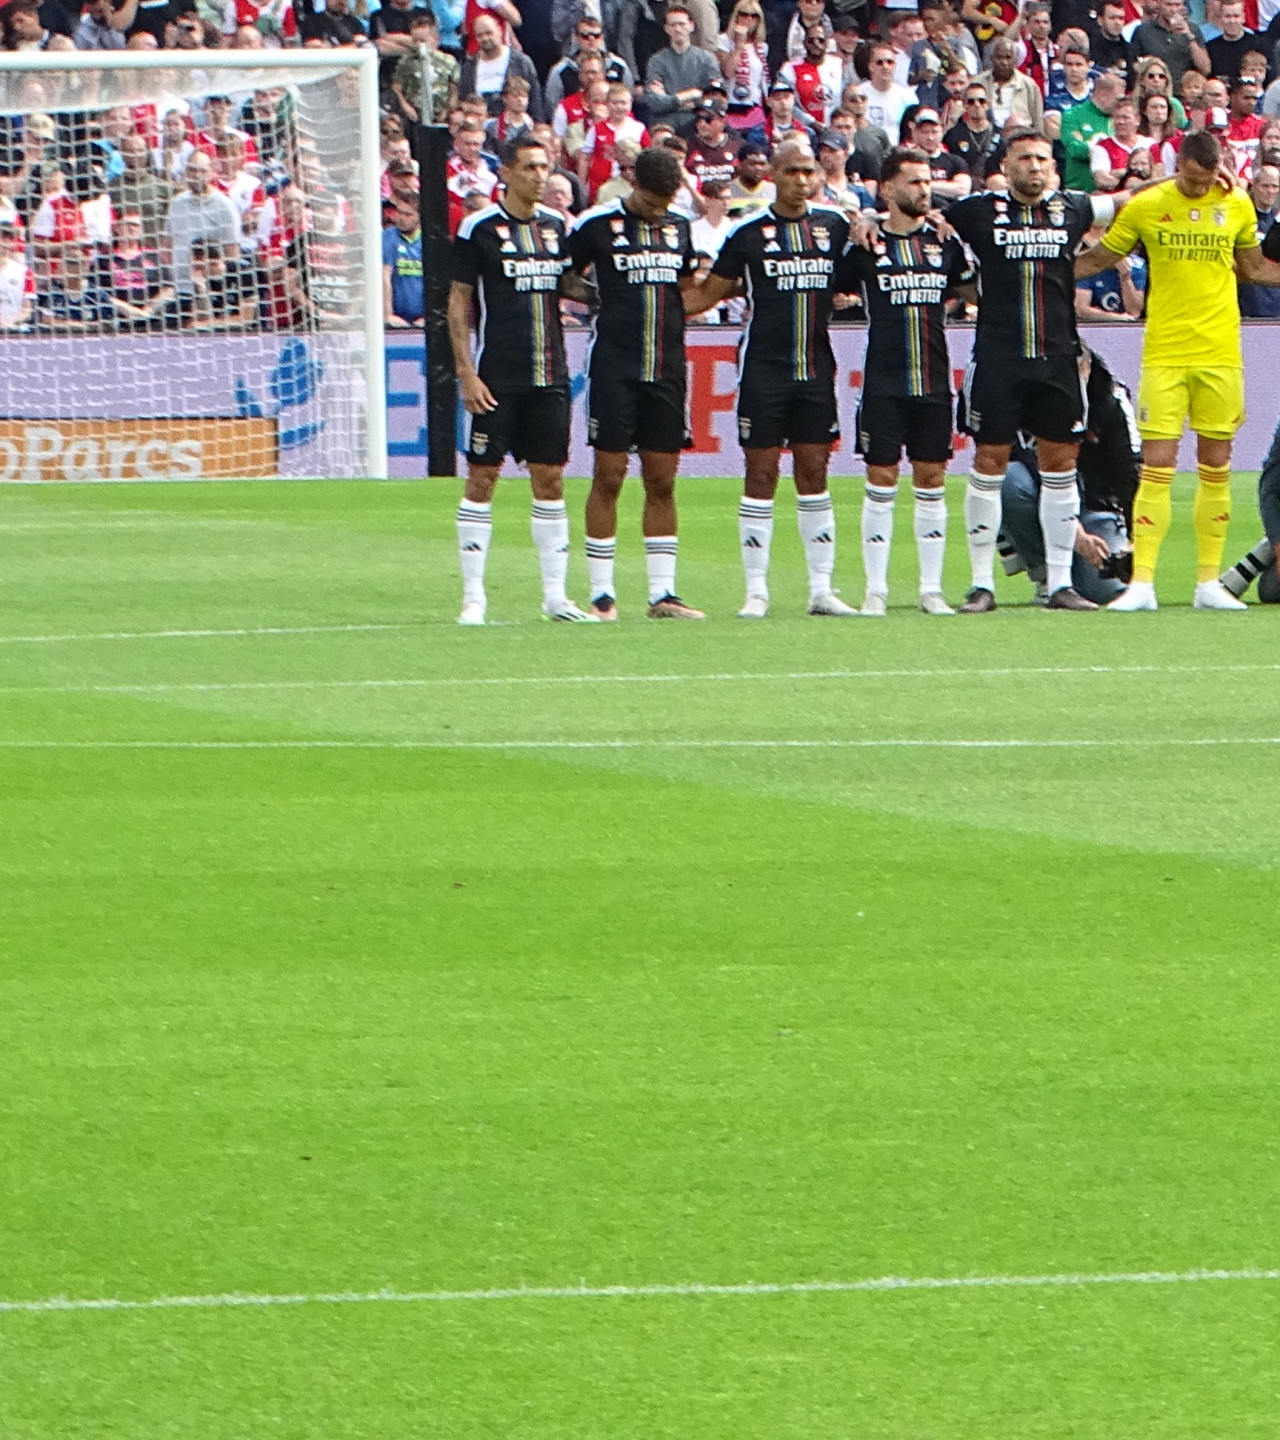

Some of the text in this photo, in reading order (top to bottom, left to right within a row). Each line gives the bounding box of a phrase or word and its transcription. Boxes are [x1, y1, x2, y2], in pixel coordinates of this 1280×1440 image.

[993, 226, 1069, 246] Emirates
[1158, 229, 1230, 249] Emirates
[1005, 244, 1060, 259] FLY BETTER
[1169, 248, 1221, 261] FLY BETTER
[763, 256, 834, 277] Emirates
[515, 276, 558, 292] FLY BETTER
[627, 268, 678, 284] FLY BETTER
[777, 274, 828, 291] FLY BETTER
[877, 270, 947, 292] Emirates
[890, 289, 942, 305] FLY BETTER
